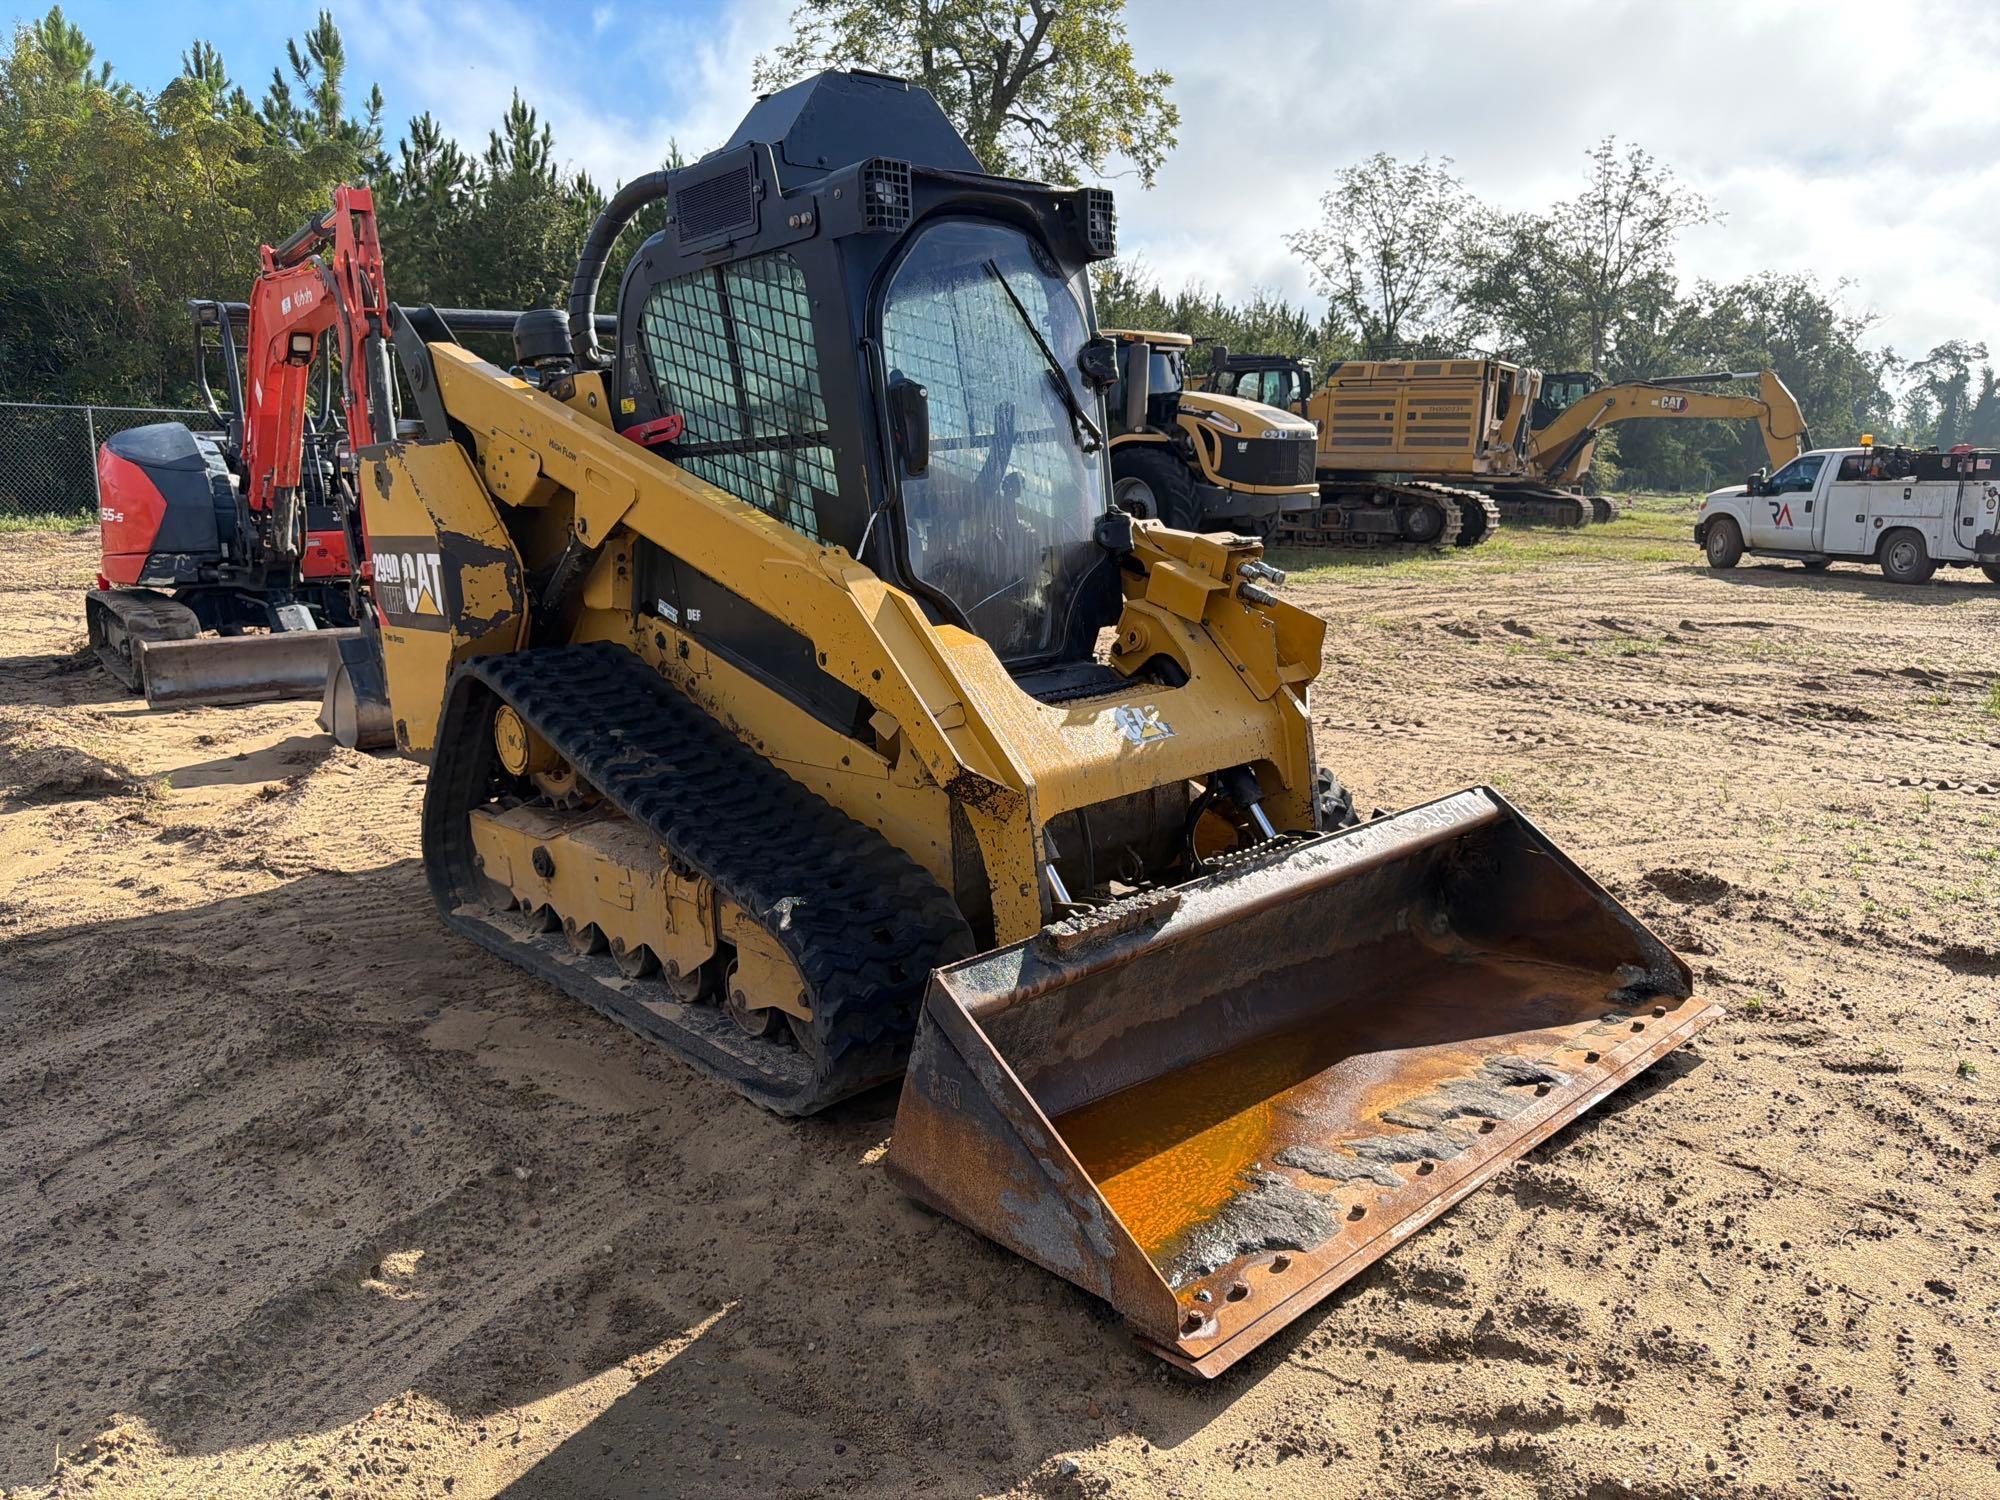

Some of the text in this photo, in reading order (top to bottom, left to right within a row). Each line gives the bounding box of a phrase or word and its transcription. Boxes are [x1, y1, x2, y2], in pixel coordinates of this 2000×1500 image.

[1661, 396, 1682, 410] CAT
[372, 553, 400, 583] 299D
[401, 552, 444, 616] CAT
[686, 608, 701, 622] DEF
